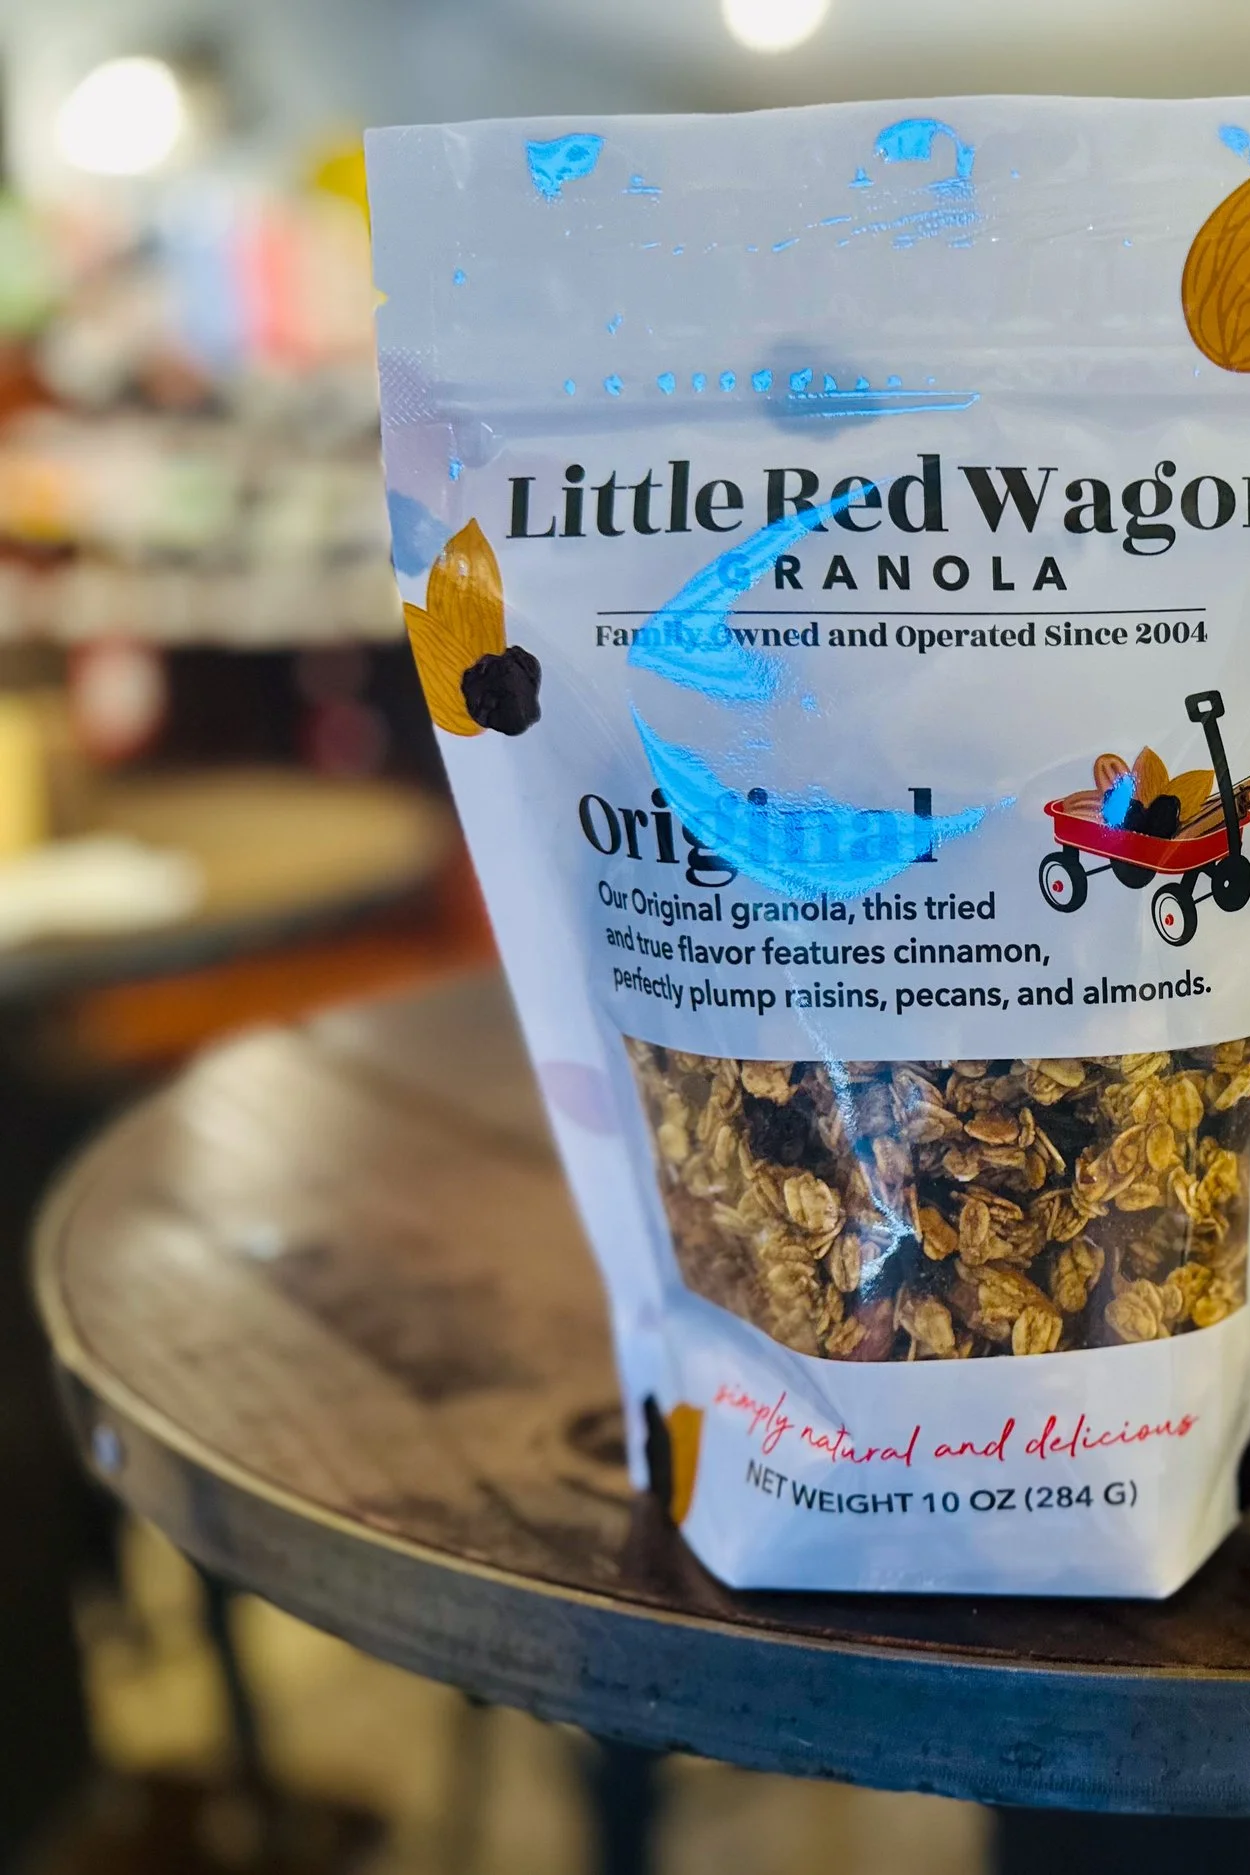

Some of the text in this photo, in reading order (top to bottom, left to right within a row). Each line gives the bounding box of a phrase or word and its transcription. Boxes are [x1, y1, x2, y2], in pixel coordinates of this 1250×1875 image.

[506, 459, 744, 540] Little
[763, 453, 949, 533] Red
[717, 554, 1068, 592] GRANOLA
[595, 619, 1208, 655] Family Owned and Operated Since 2004
[578, 787, 939, 888] Original
[598, 879, 996, 930] Our Original granola, this tried
[606, 925, 1051, 967] and true flavor features cinnamon,
[613, 964, 1213, 1016] perfectly plump raisins, pecans, and almonds.
[712, 1384, 1200, 1467] simply natural and delicious
[746, 1458, 1138, 1515] NET WEIGHT 10 OZ (284 G)
